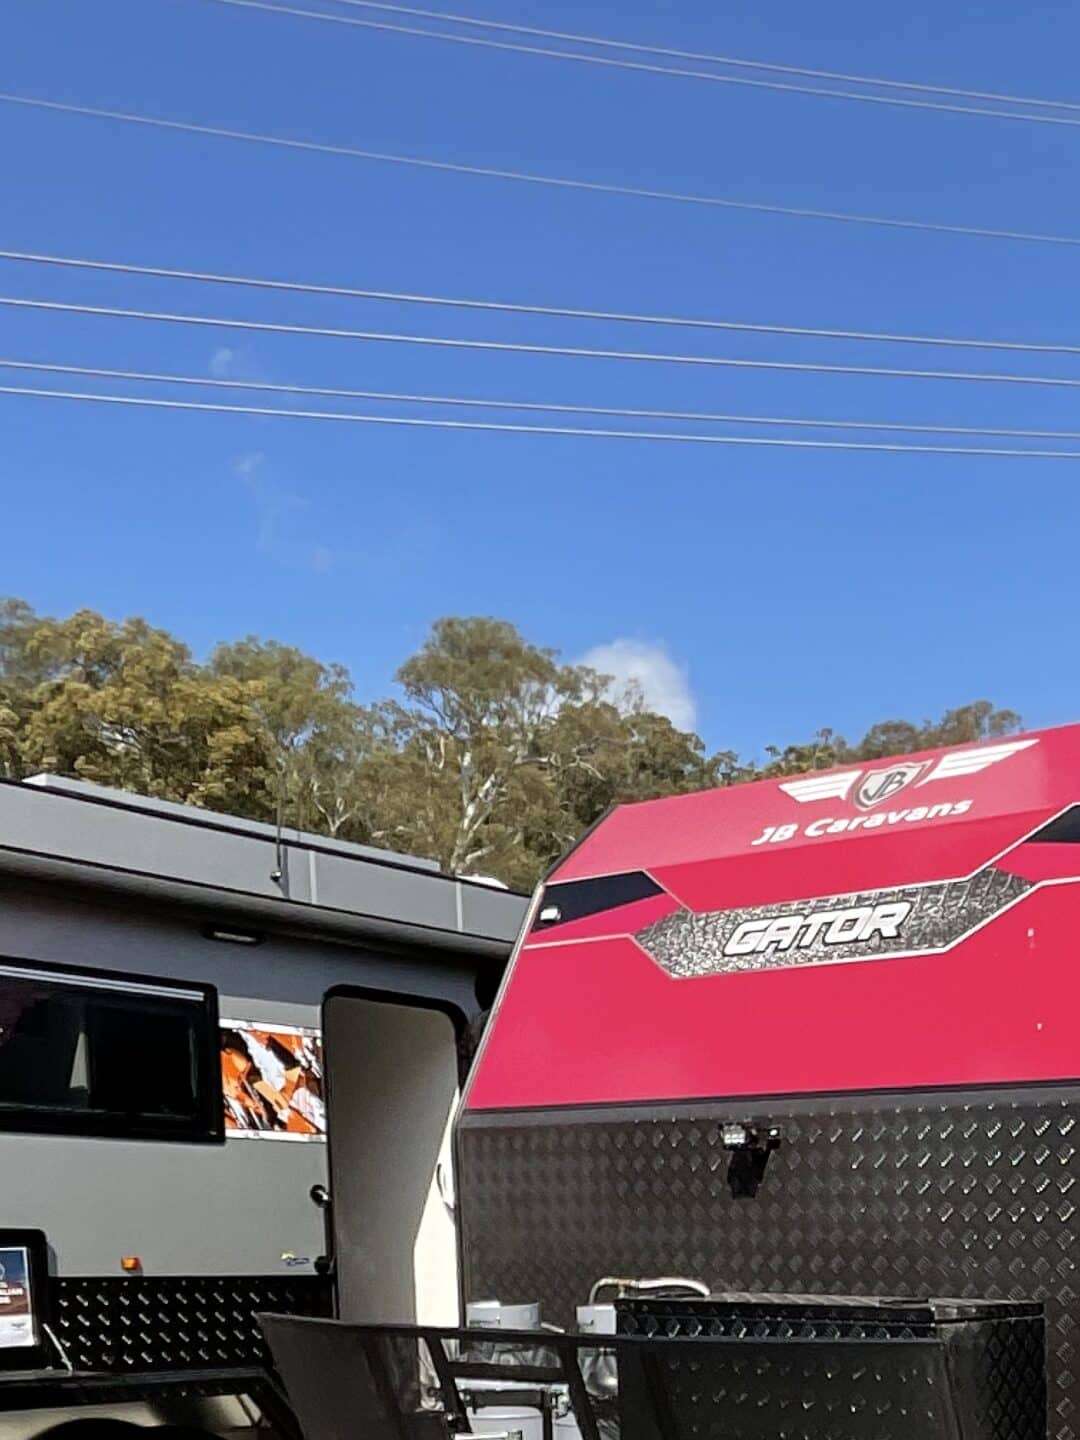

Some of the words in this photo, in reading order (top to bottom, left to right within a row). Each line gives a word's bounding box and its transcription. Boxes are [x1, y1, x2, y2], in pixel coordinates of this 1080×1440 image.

[862, 771, 905, 801] JB
[751, 823, 798, 846] JB
[804, 799, 974, 838] Caravans
[724, 902, 912, 955] GATOR
